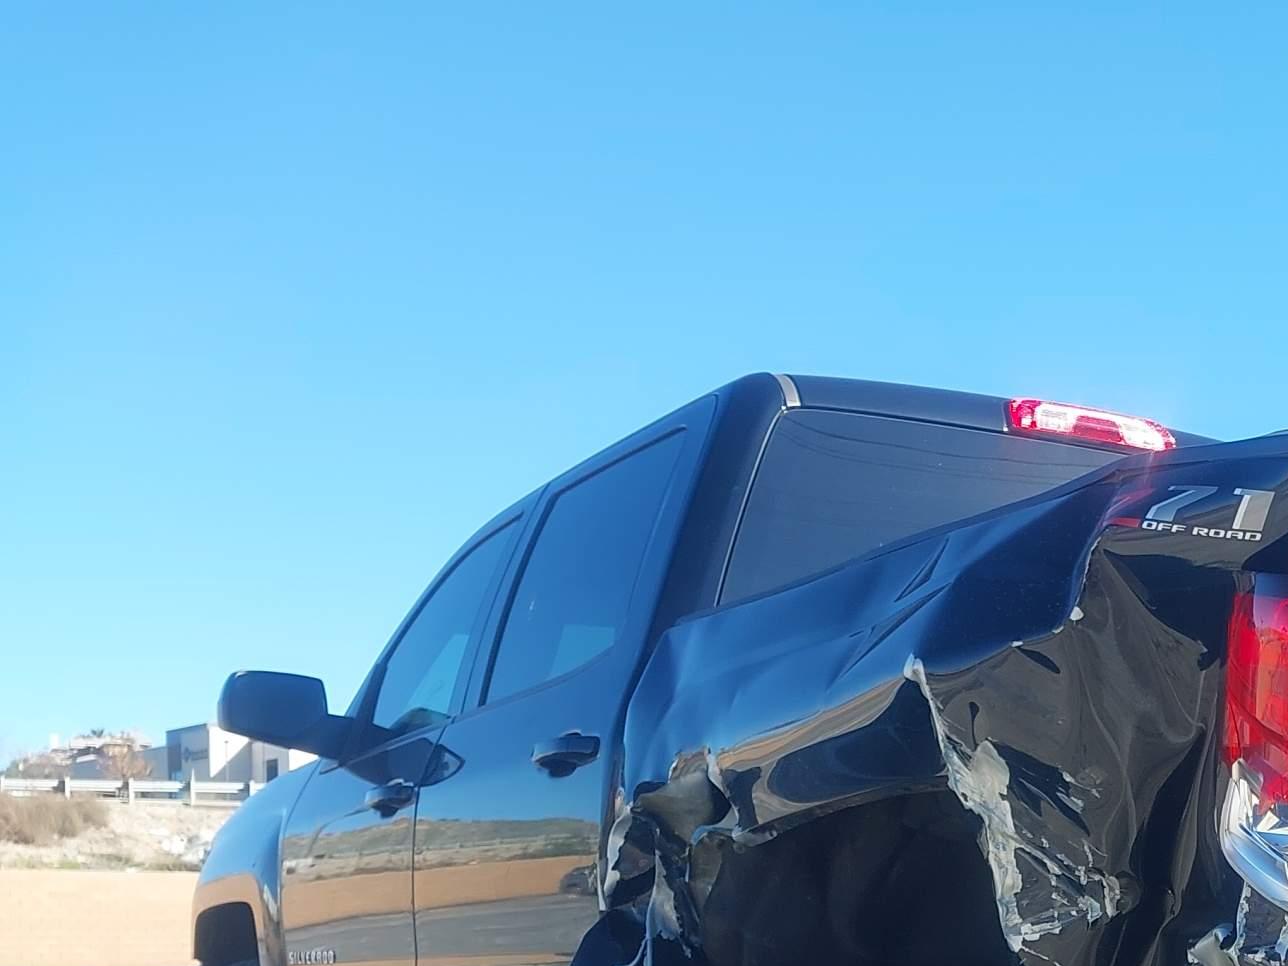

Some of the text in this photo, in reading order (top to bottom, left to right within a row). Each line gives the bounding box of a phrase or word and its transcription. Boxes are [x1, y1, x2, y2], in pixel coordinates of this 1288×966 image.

[1141, 520, 1262, 541] OFF ROAD
[288, 950, 335, 965] SILVERADO
